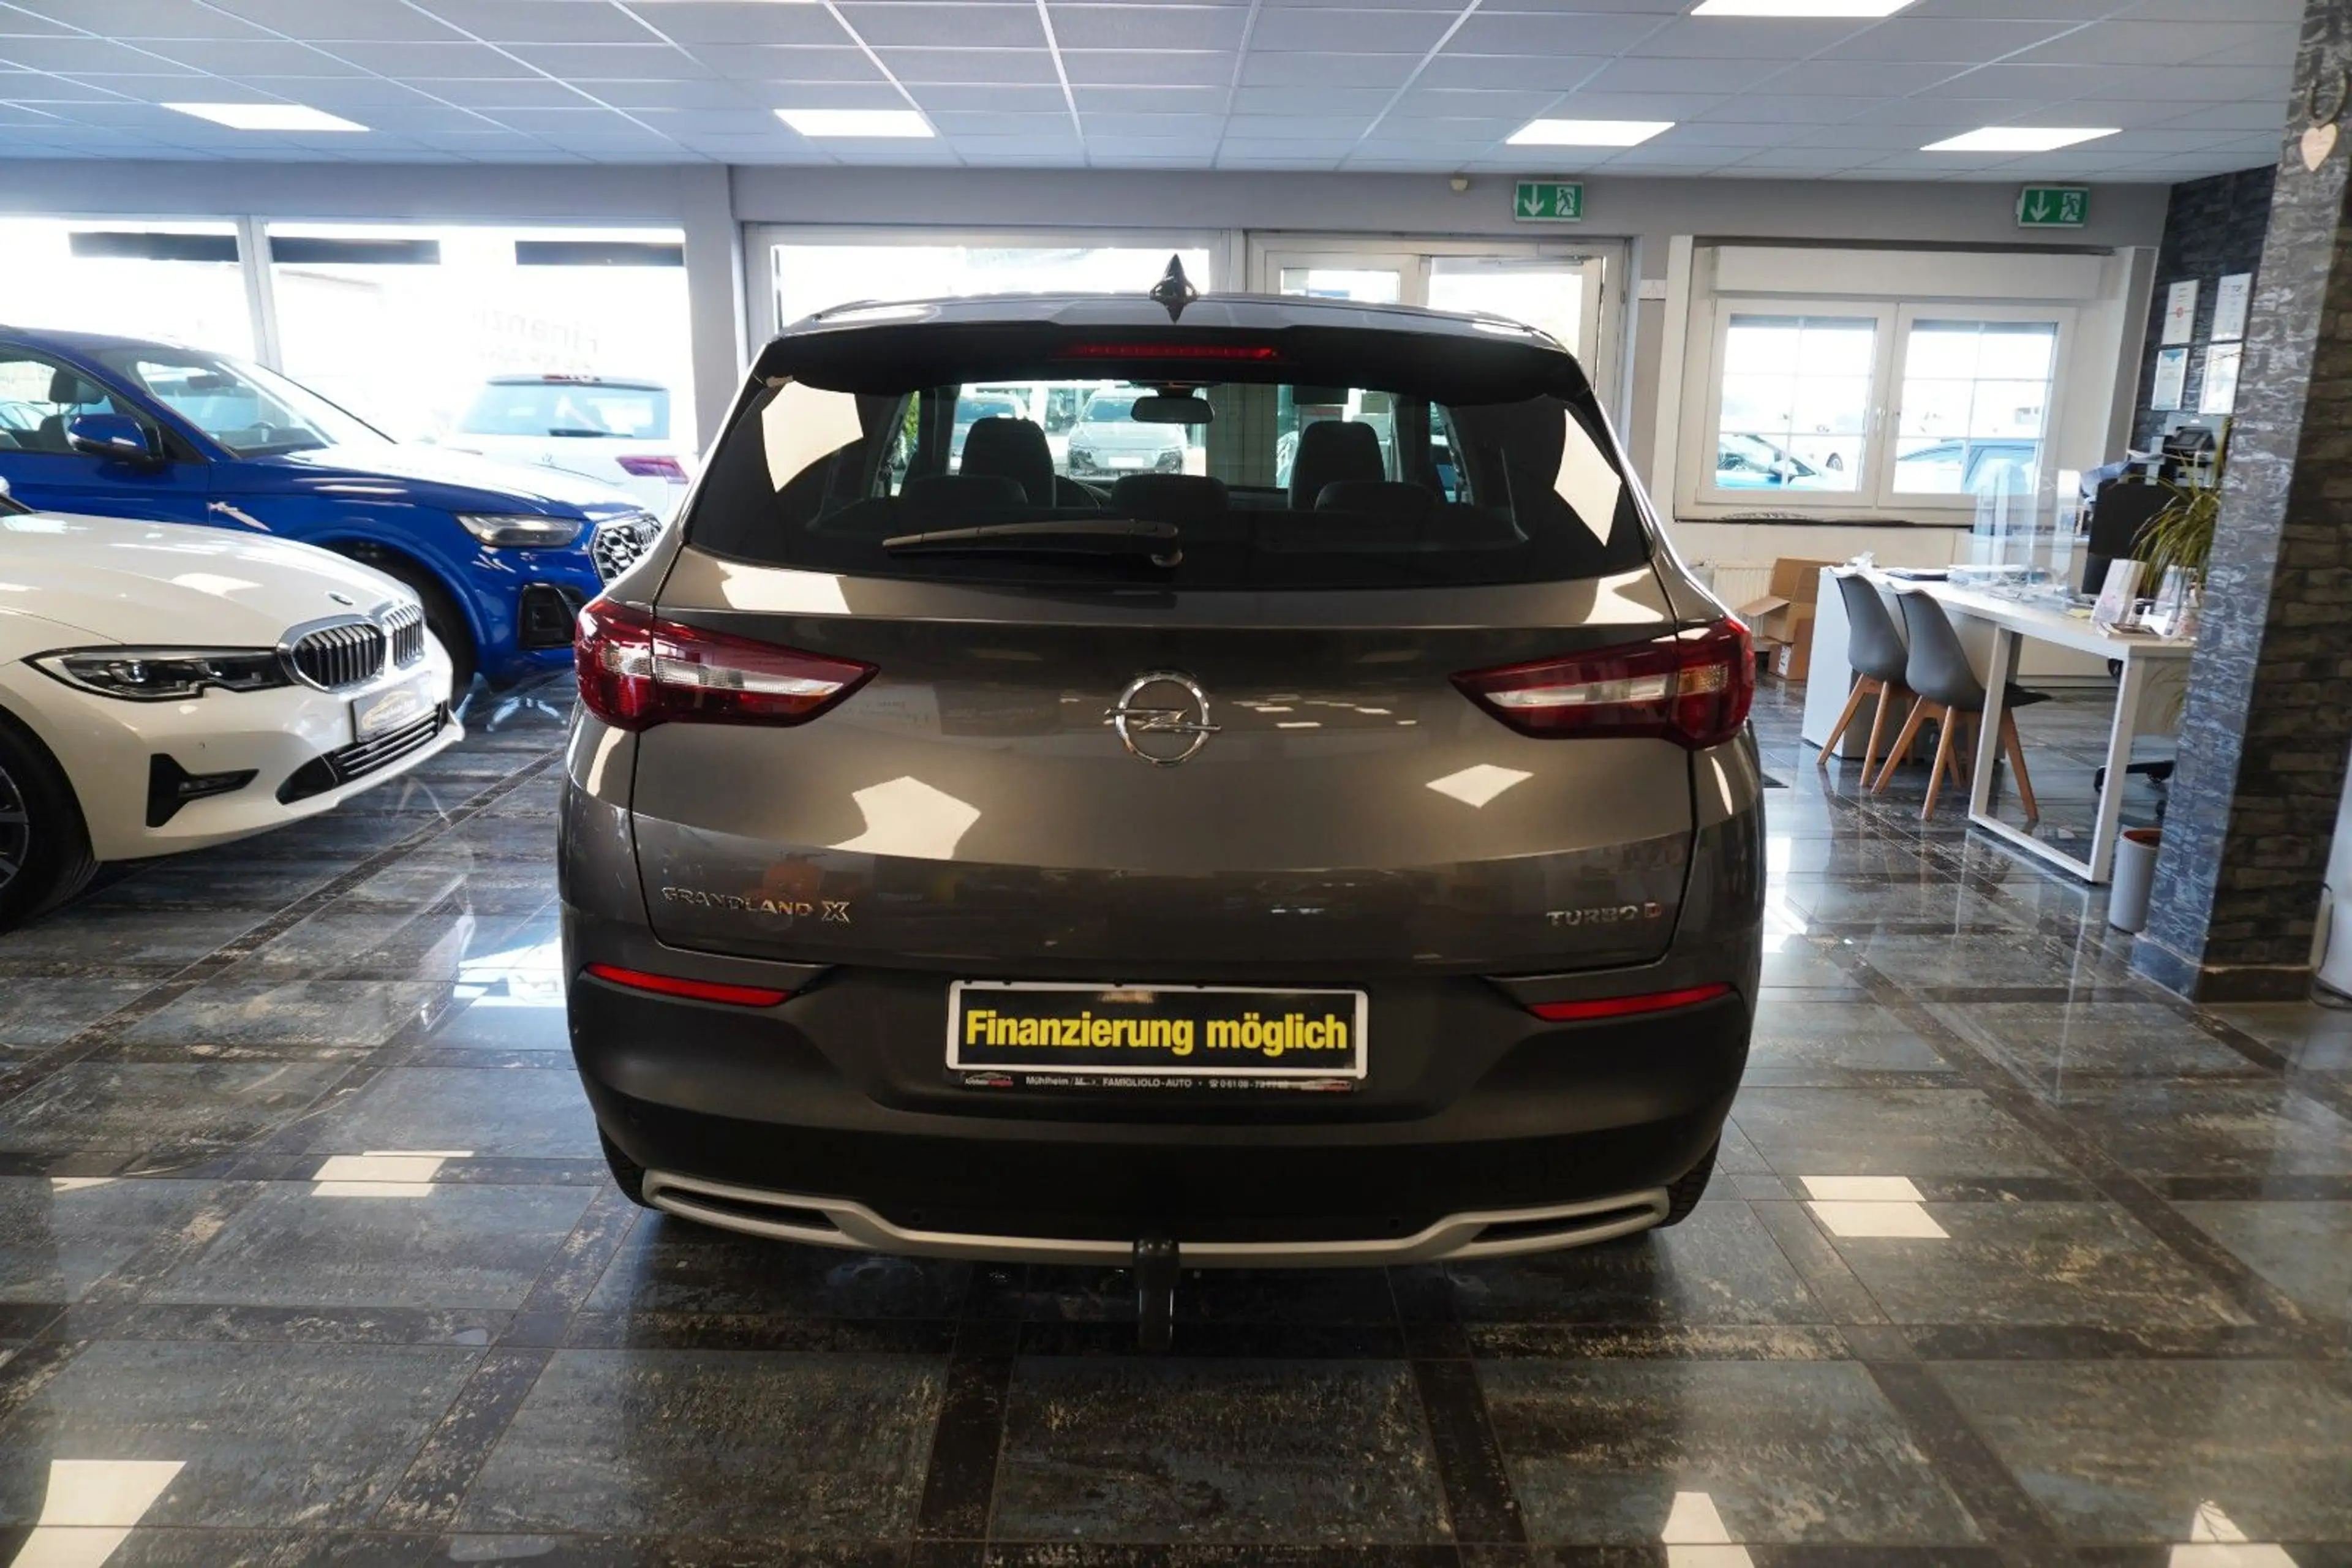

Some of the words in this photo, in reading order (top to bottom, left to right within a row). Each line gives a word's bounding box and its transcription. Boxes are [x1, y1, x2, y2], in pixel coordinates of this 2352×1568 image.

[662, 886, 813, 916] GRANDLAND
[821, 900, 850, 923] X
[1546, 905, 1638, 927] TURBO
[967, 1009, 1194, 1055] Finanzierung
[1206, 1012, 1347, 1057] möglich
